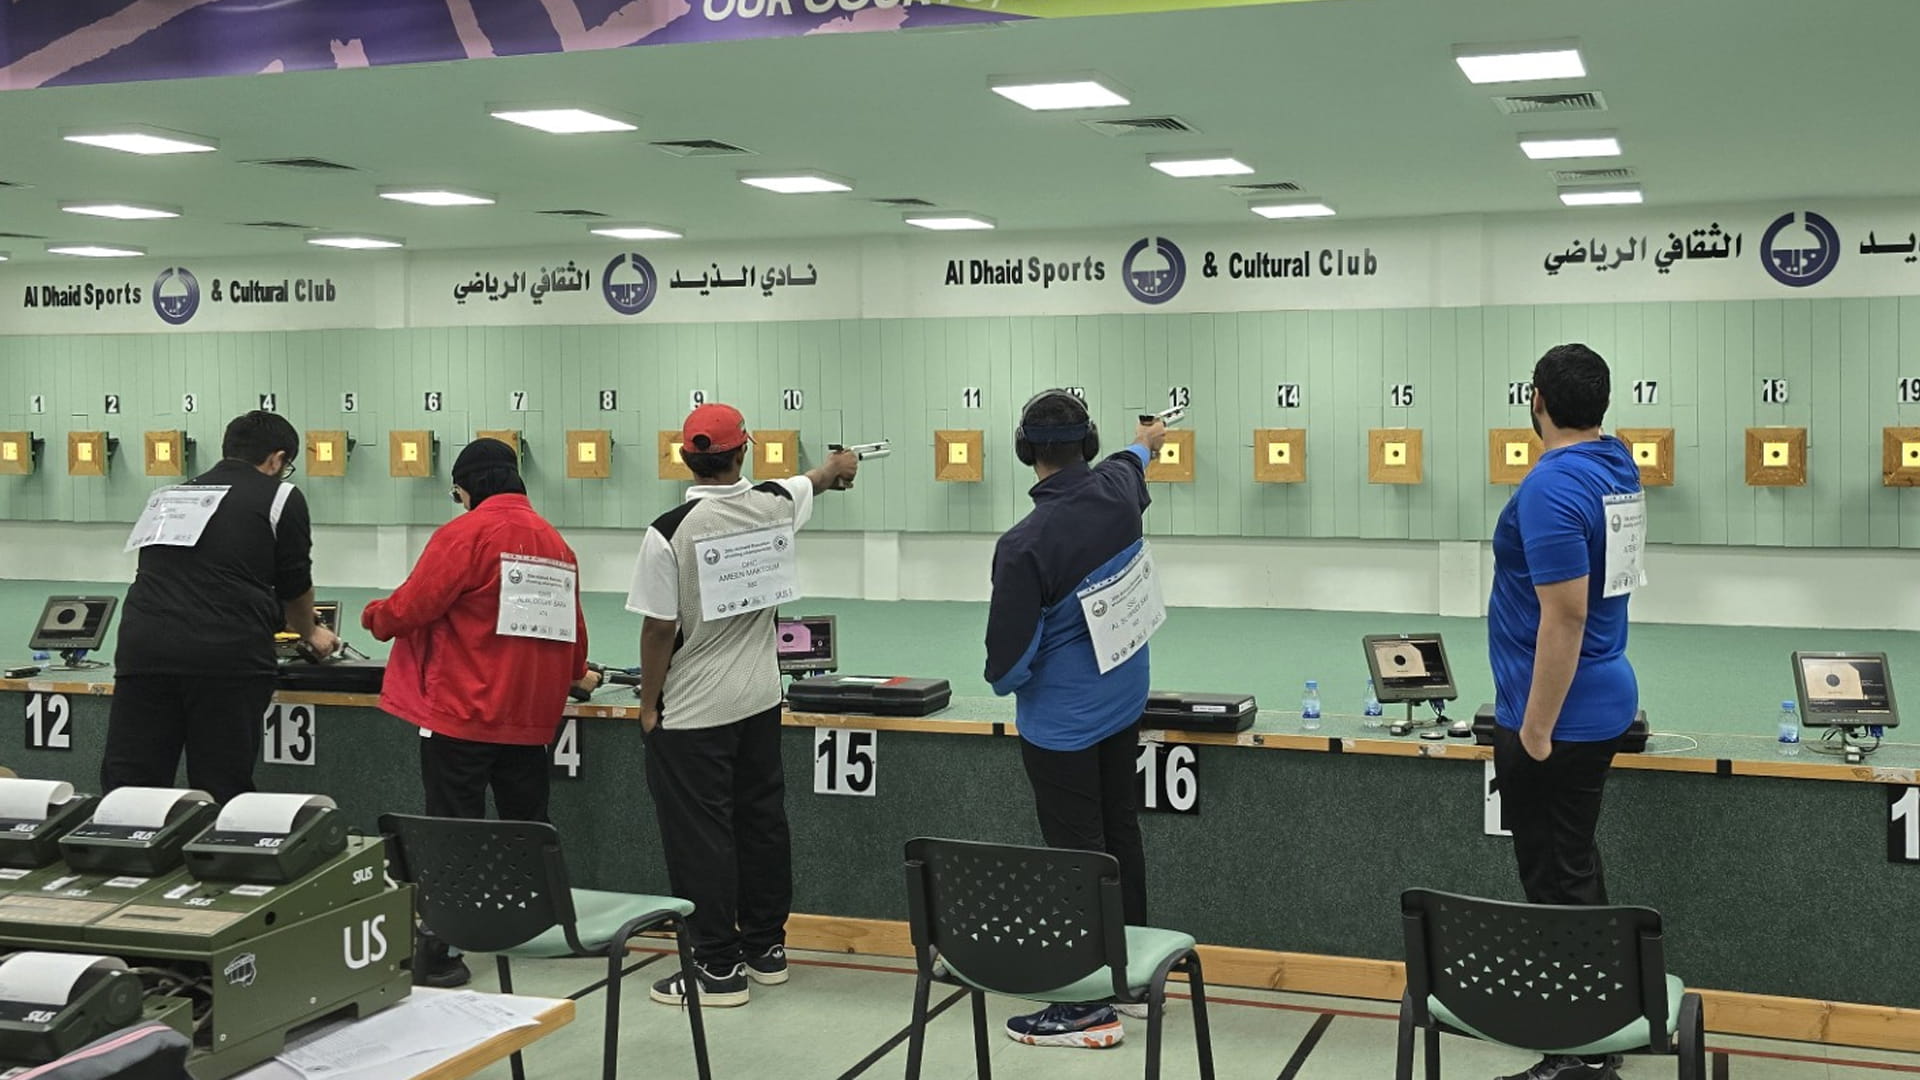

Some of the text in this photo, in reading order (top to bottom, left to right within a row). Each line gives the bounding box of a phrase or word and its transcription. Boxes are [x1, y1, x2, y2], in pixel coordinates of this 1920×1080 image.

[1544, 237, 1646, 275] الرياضي
[1655, 223, 1741, 273] الثقافي
[945, 248, 1376, 288] Al Dhaid Sports & Cultural Club
[454, 260, 817, 305] نادي الذيد الثقافي الرياضي
[24, 279, 335, 310] Al Dhaid Sports & Cultural Club
[514, 392, 524, 409] 7
[602, 391, 613, 409] 8
[693, 391, 704, 408] 9
[785, 390, 802, 409] 10
[963, 389, 981, 408] 11
[1169, 387, 1189, 407] 13
[1278, 385, 1299, 406] 14
[1391, 385, 1413, 406] 15
[1633, 381, 1657, 403] 17
[1763, 380, 1788, 403] 18
[1899, 379, 1920, 401] 19
[34, 396, 41, 412] 1
[107, 396, 118, 412] 2
[185, 395, 193, 411] 3
[263, 394, 273, 413] 4
[345, 394, 353, 410] 5
[428, 393, 438, 410] 6
[25, 693, 70, 748] 12
[265, 704, 312, 762] 13
[554, 719, 581, 777] 4
[817, 729, 873, 792] 15
[1136, 741, 1197, 811] 16
[1892, 787, 1920, 860] 1
[352, 866, 374, 885] SIUS
[343, 914, 388, 970] US
